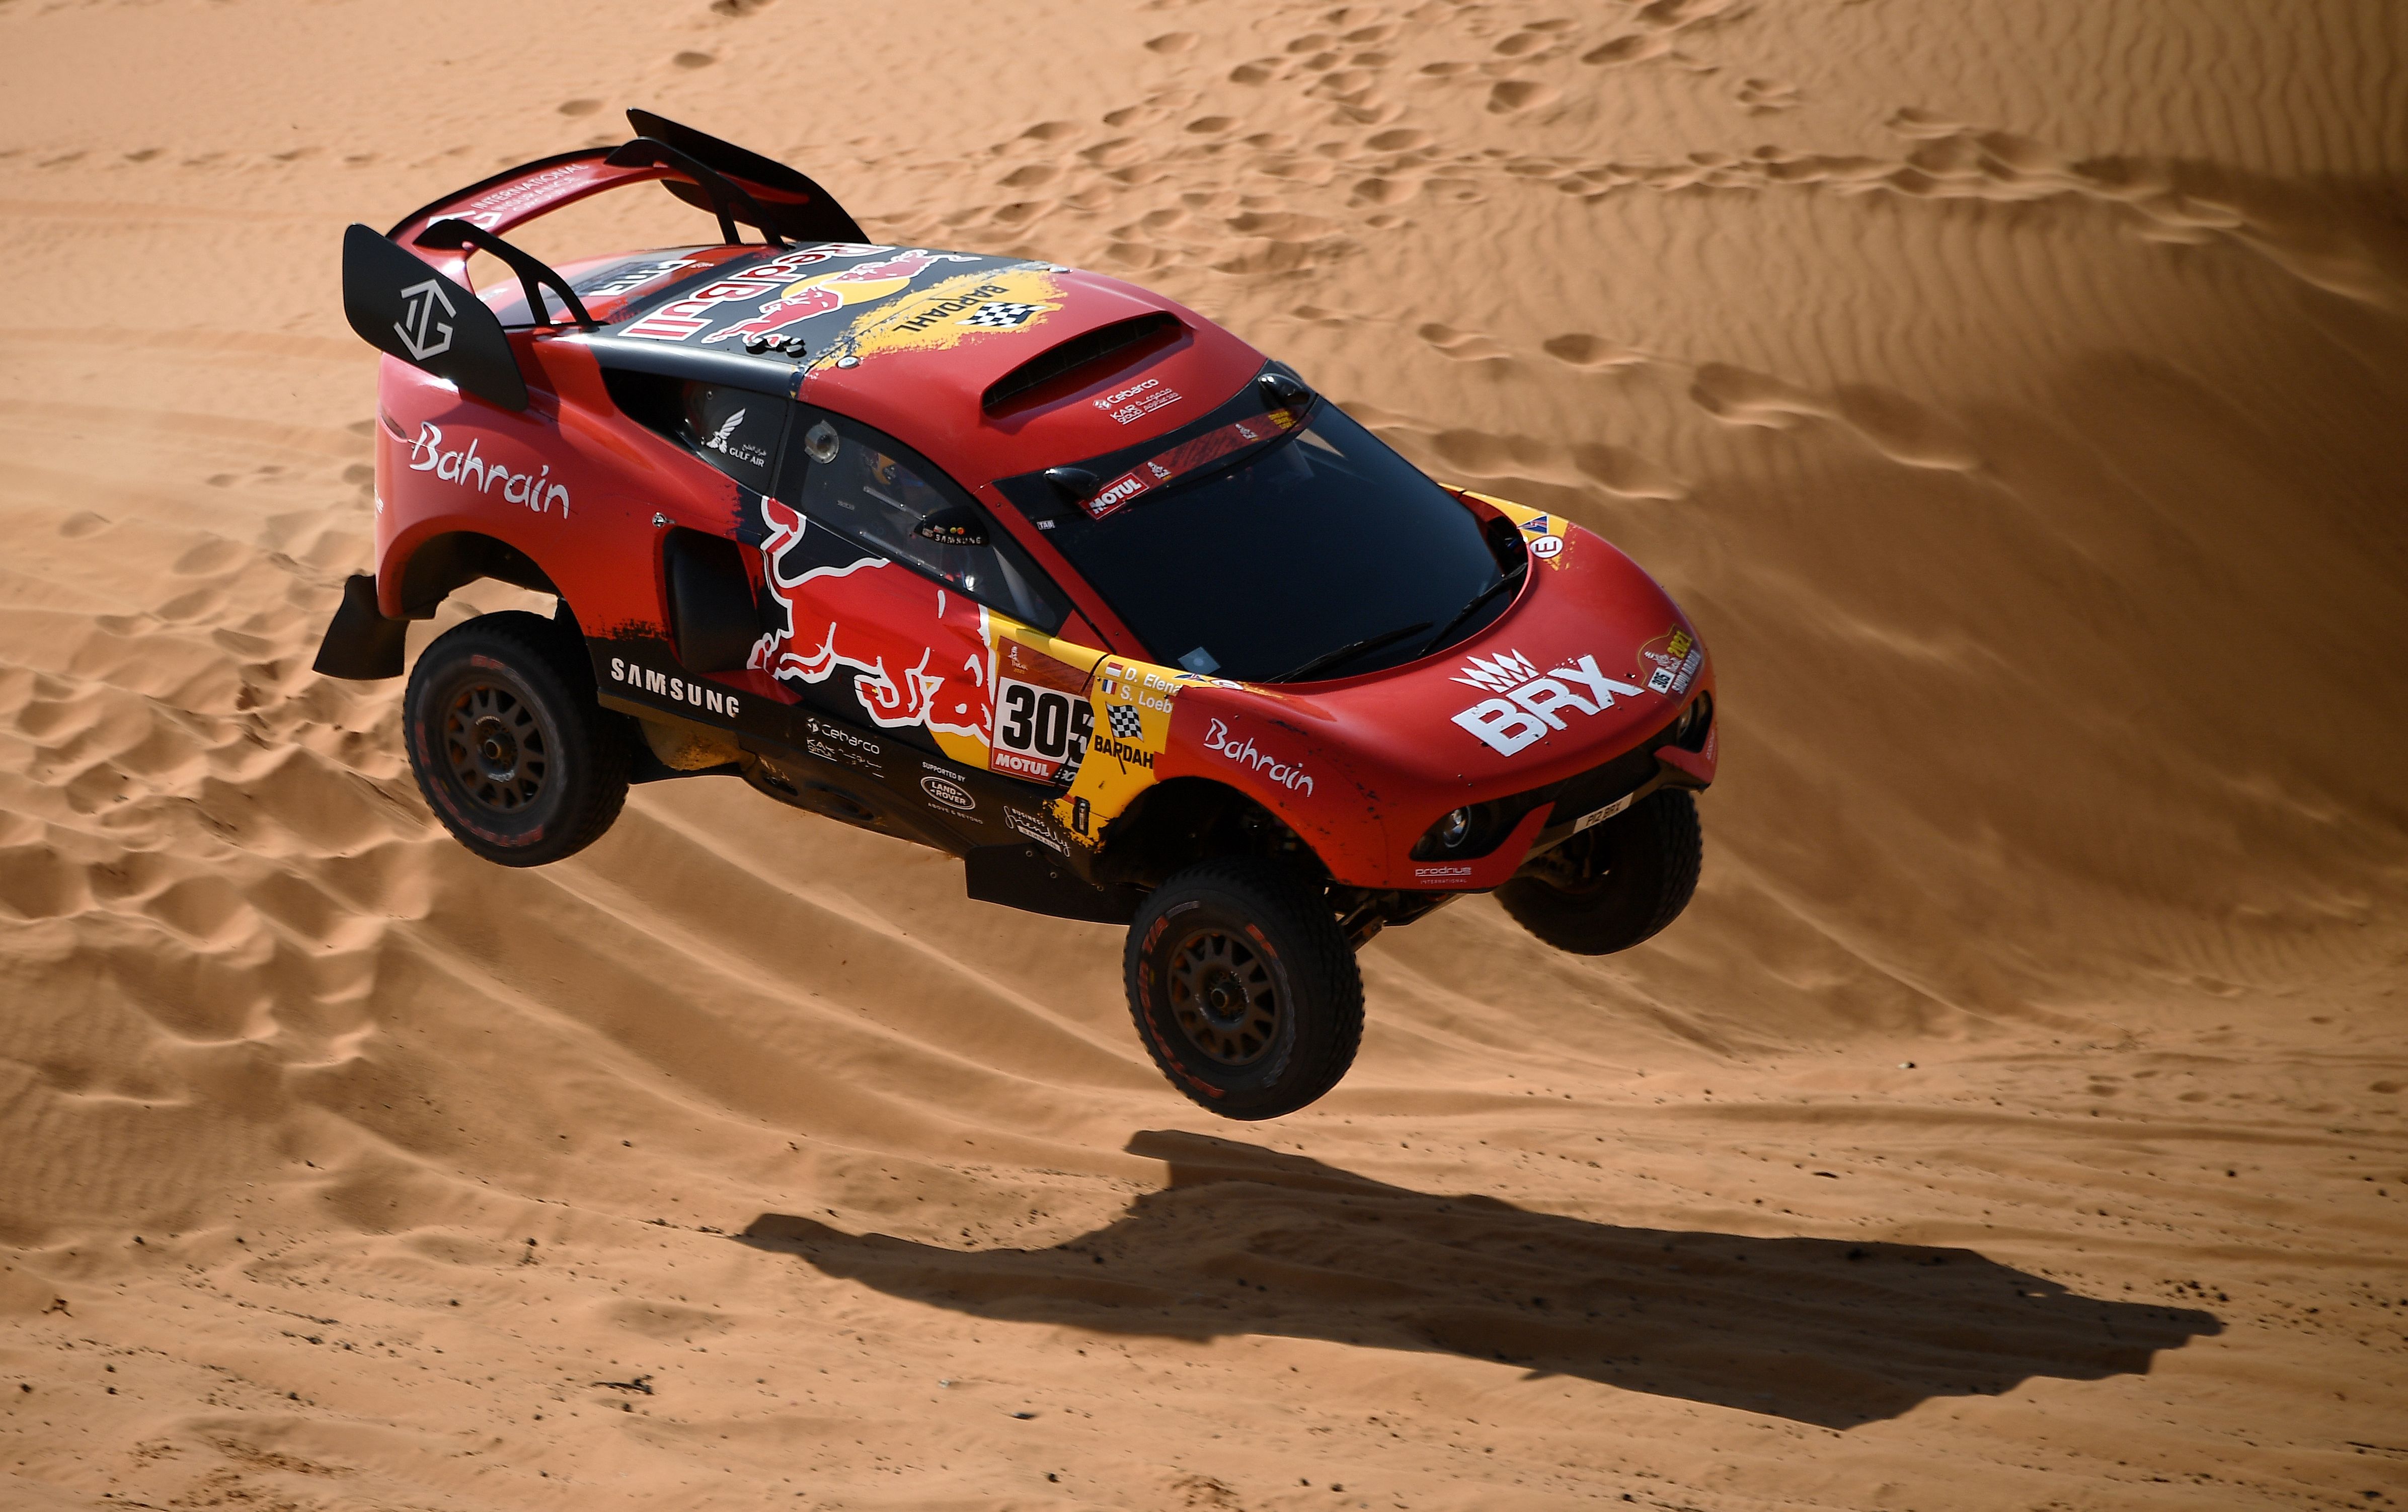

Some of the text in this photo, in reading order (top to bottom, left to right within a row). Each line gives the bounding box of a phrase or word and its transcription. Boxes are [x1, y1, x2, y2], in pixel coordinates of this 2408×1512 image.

[471, 164, 589, 210] INTERNATIONAL
[618, 282, 780, 341] Bull
[892, 284, 1009, 333] BARDAHL
[1107, 379, 1159, 404] Cebarco
[1110, 404, 1136, 420] KAR
[730, 447, 764, 467] GULF AIR
[408, 422, 570, 519] Bahrain
[1089, 479, 1143, 514] MOTUL
[1039, 521, 1053, 529] TAB
[1124, 667, 1137, 683] D.
[610, 658, 740, 718] SAMSUNG
[1120, 685, 1174, 713] S. Loeb
[1450, 654, 1645, 757] BRX
[1002, 684, 1094, 764] 305
[922, 761, 957, 779] SUPPORTED
[995, 753, 1049, 777] MOTUL
[1203, 718, 1314, 798] Bahrain
[931, 781, 956, 795] LAND
[936, 790, 966, 805] ROVER
[927, 803, 950, 813] ABOVE
[957, 812, 983, 824] BEYOND
[1012, 808, 1046, 827] BUSINESS
